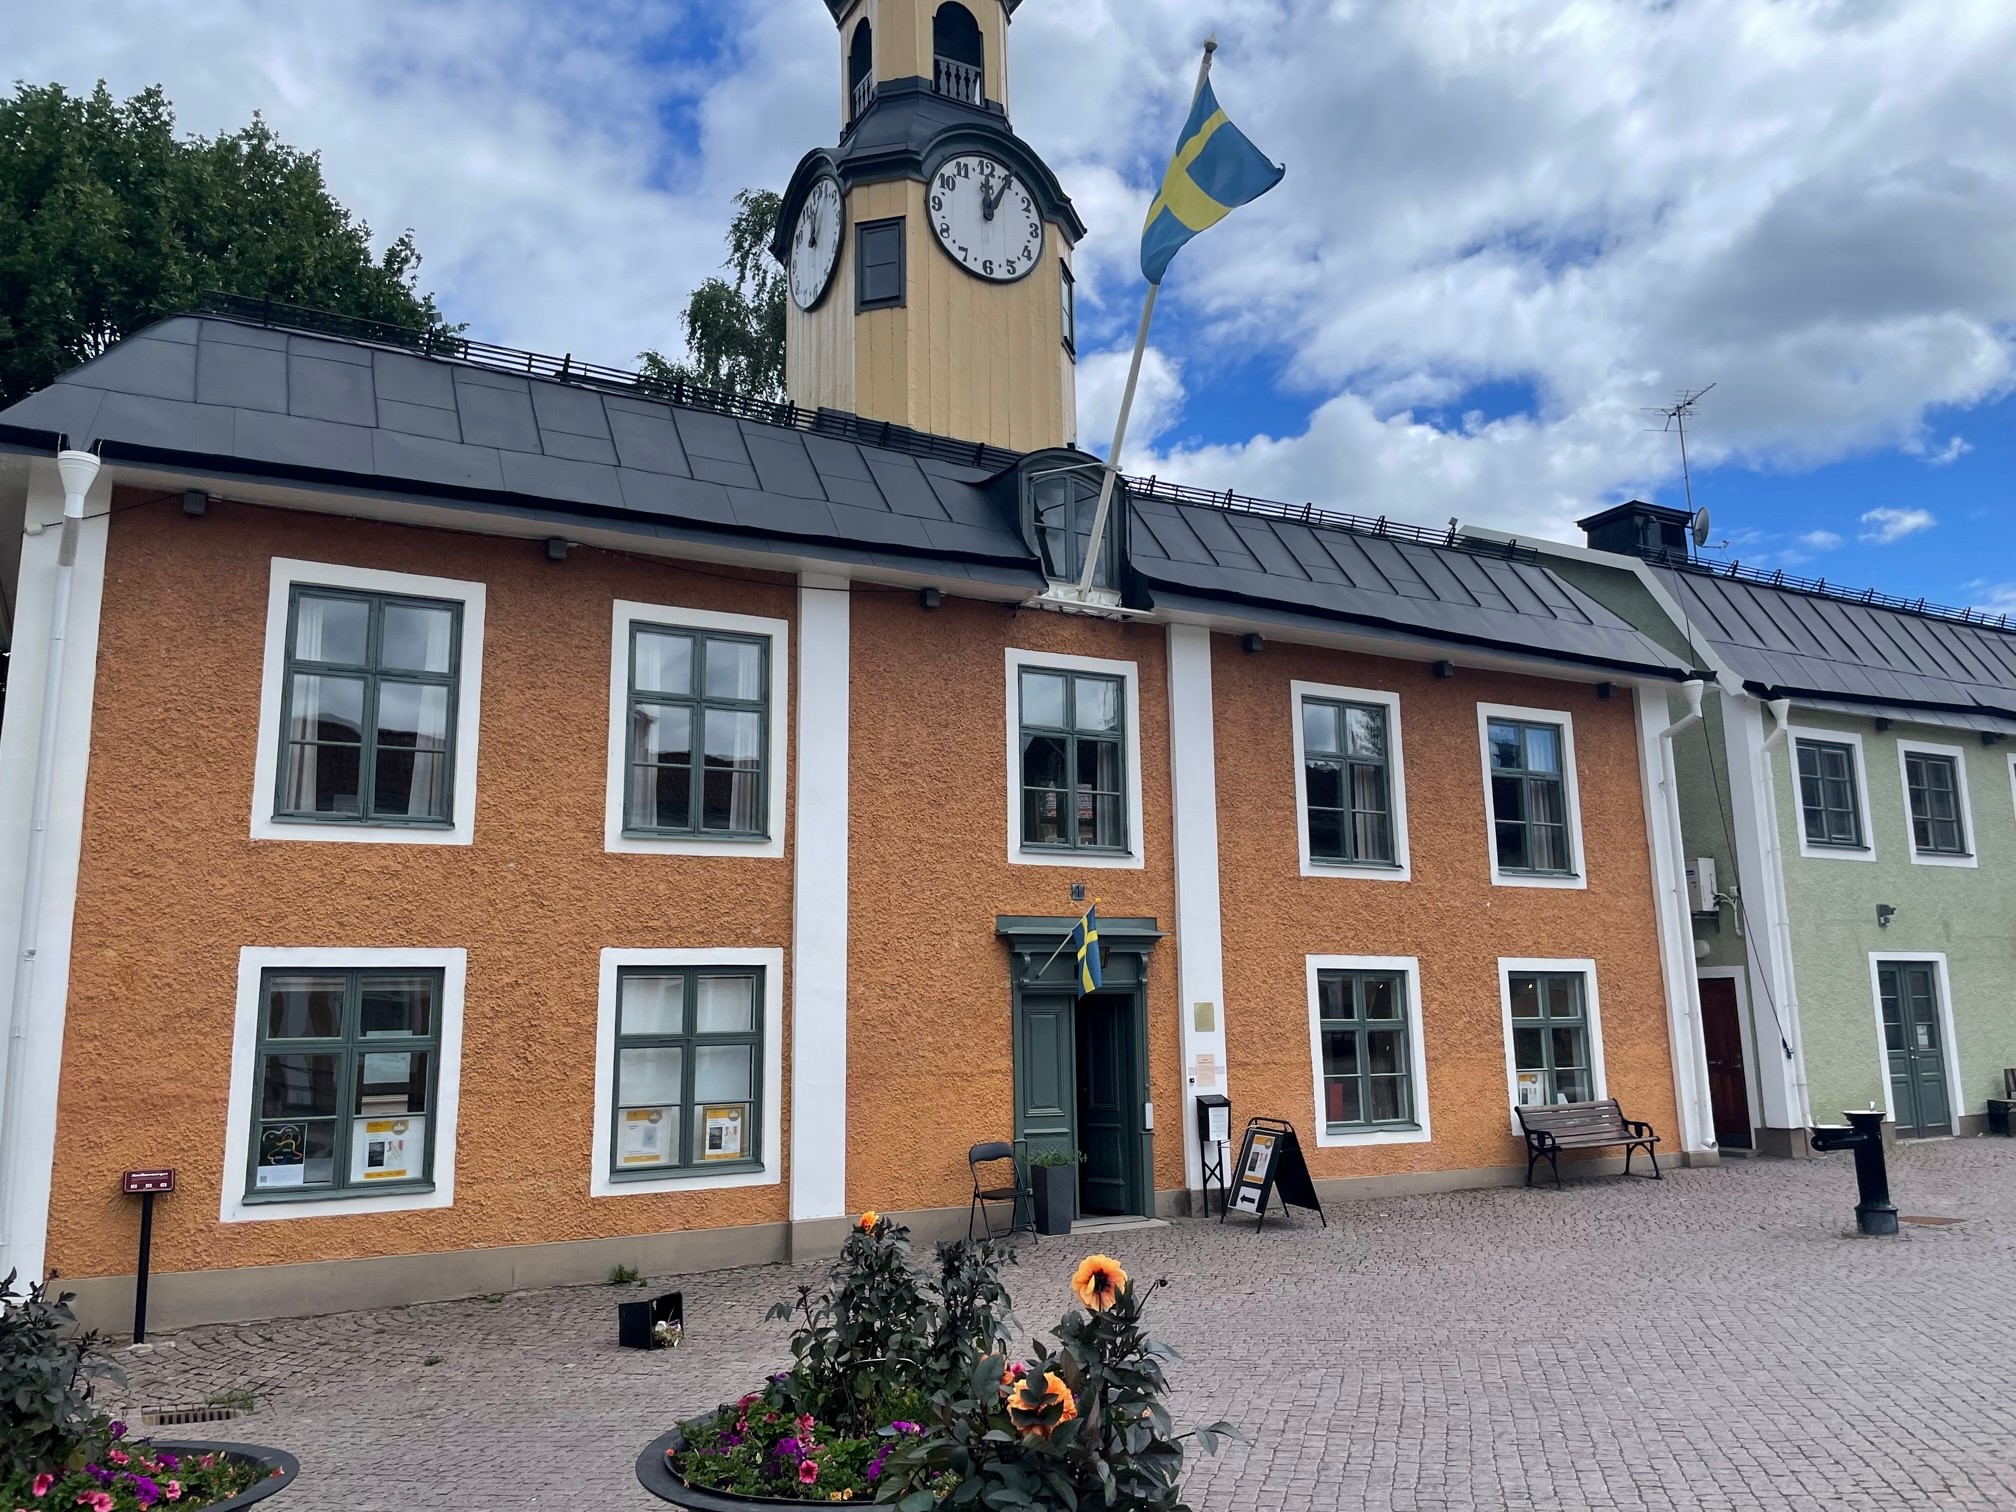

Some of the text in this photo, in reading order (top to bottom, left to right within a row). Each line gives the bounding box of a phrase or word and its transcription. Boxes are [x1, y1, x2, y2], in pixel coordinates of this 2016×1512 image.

[954, 162, 970, 180] 11
[977, 161, 996, 179] 12
[938, 173, 956, 191] 10
[931, 196, 943, 212] 9
[1021, 197, 1032, 214] 2
[939, 223, 950, 239] 8
[1029, 223, 1039, 239] 3
[795, 230, 803, 249] 10
[958, 246, 968, 262] 7
[1021, 246, 1033, 262] 4
[792, 260, 797, 275] 9
[982, 260, 994, 275] 6
[1006, 259, 1017, 275] 5
